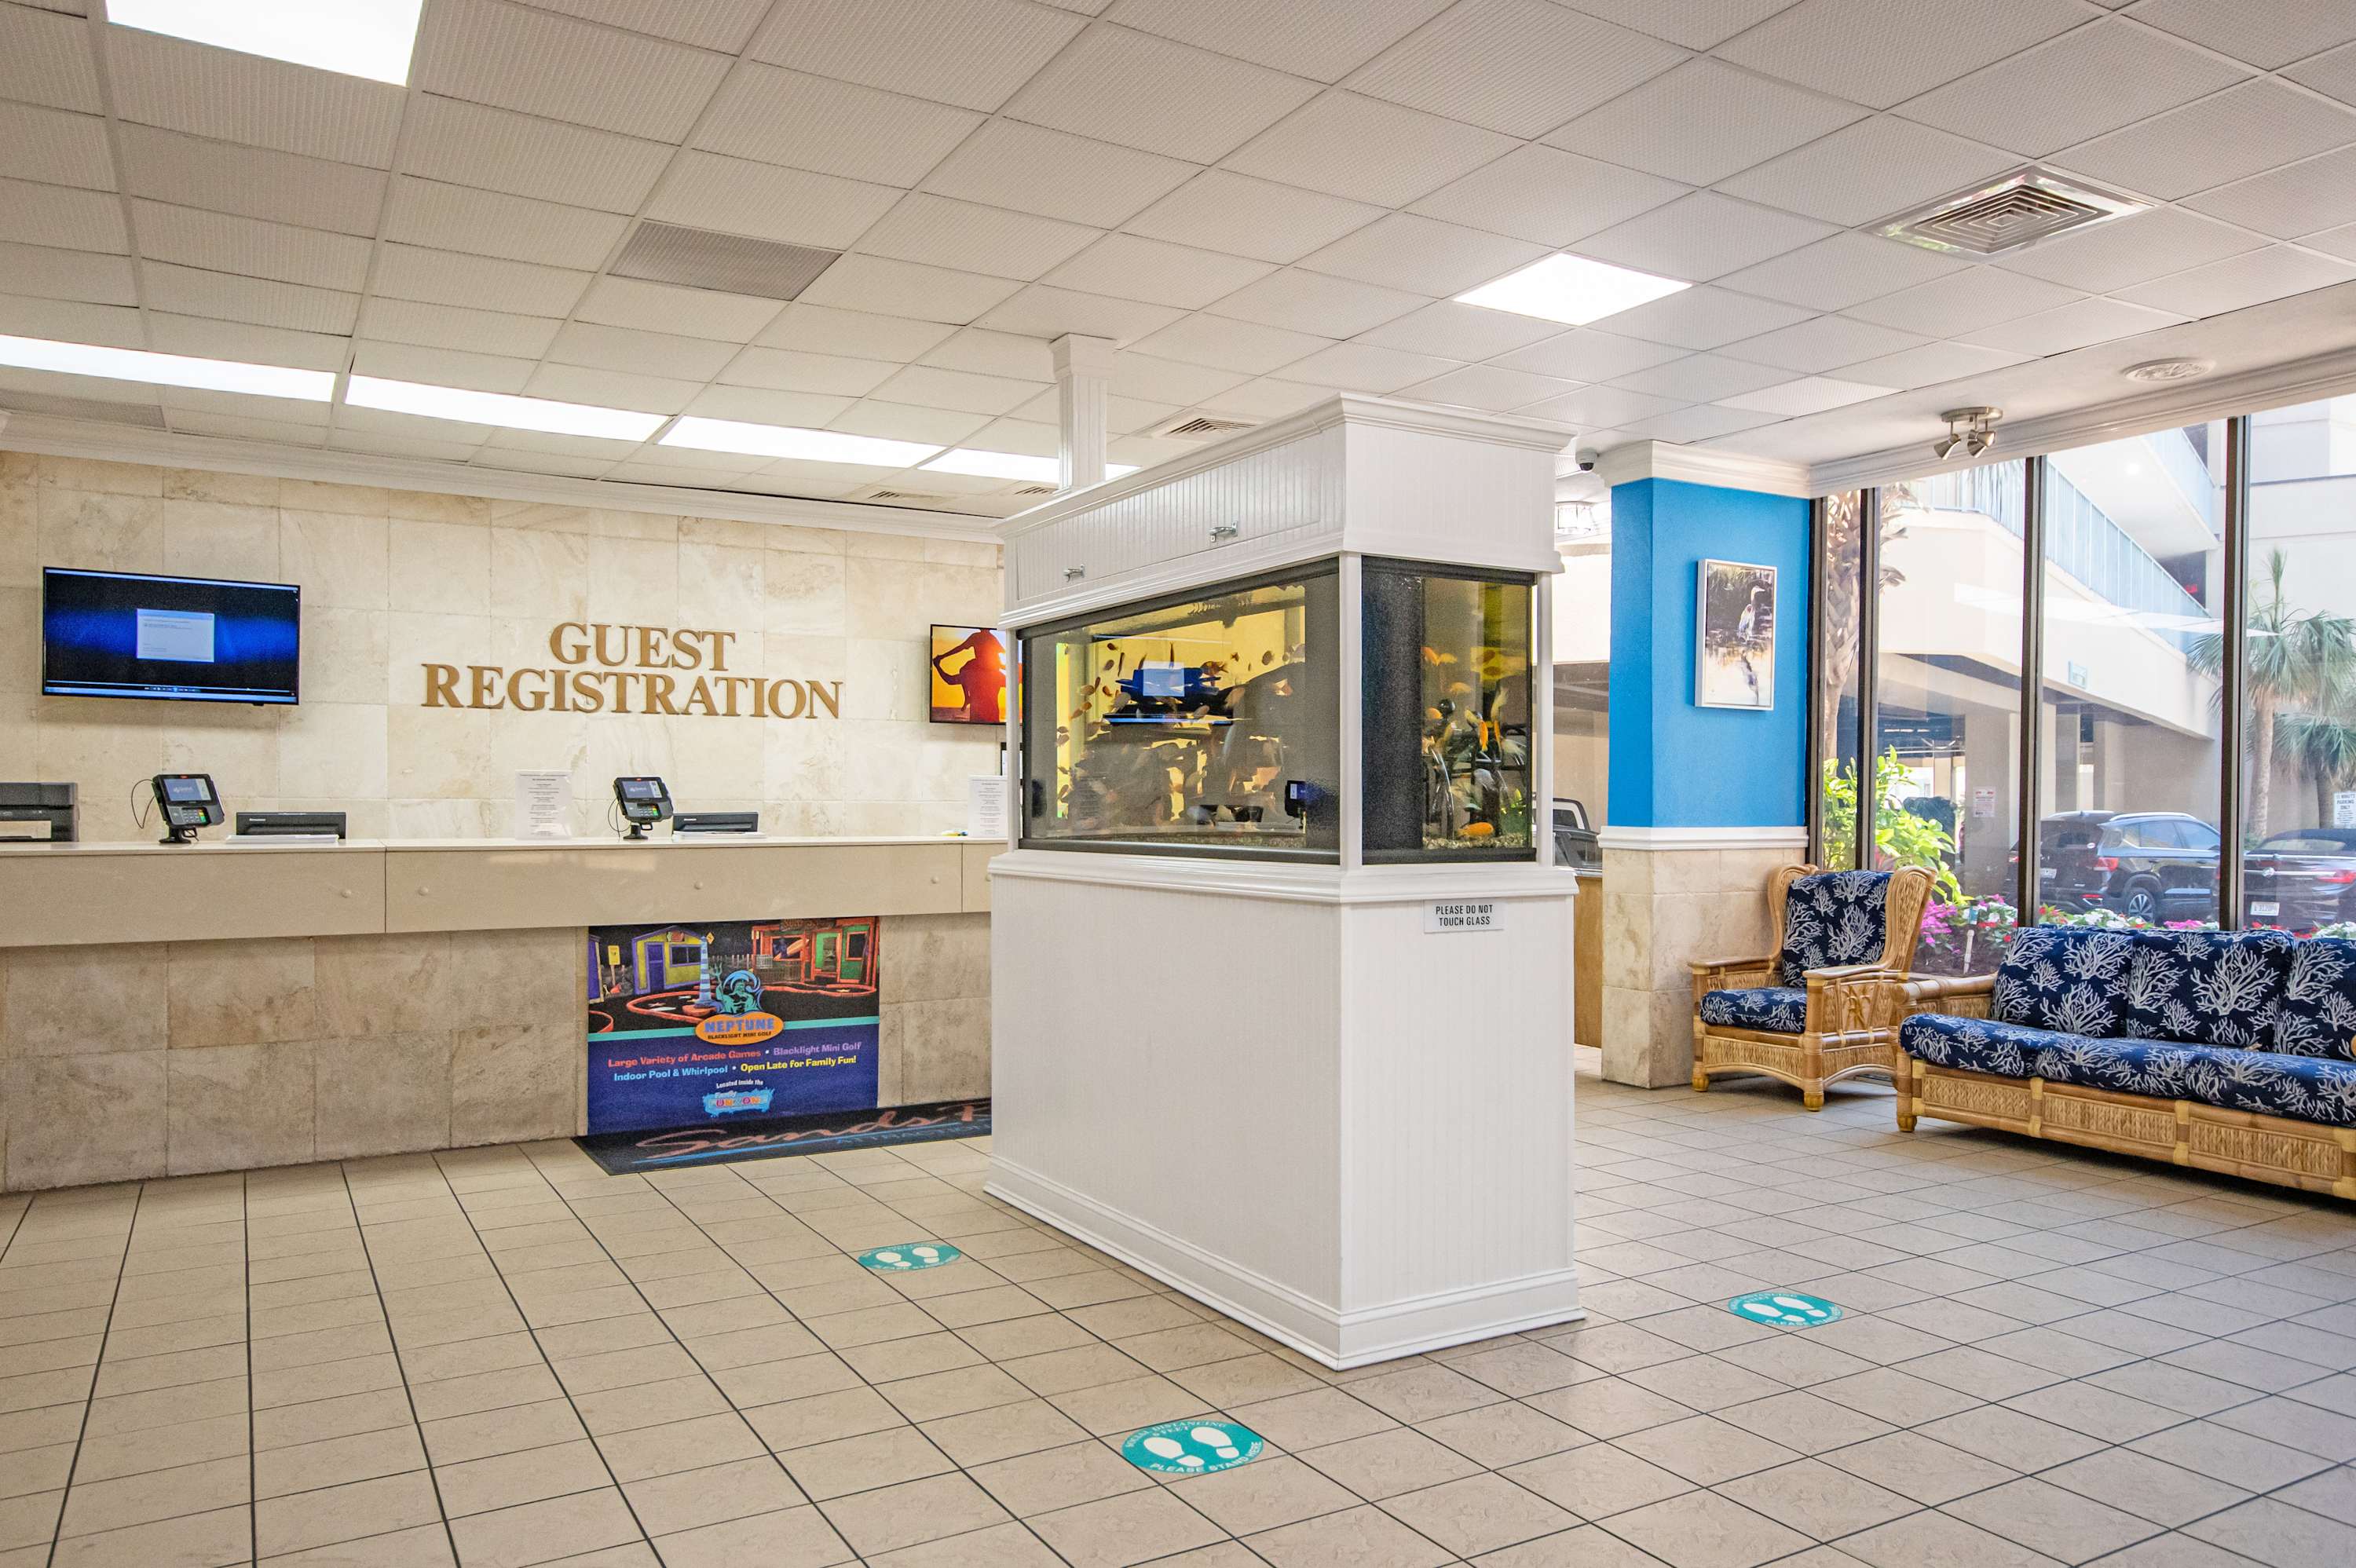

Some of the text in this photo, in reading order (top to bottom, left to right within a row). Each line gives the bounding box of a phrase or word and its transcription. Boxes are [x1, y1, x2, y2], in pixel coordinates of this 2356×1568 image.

[549, 621, 737, 671] GUEST
[420, 663, 844, 720] REGISTRATION
[1436, 905, 1493, 915] PLEASE DO NOT
[1439, 916, 1490, 927] TOUCH GLASS
[704, 1018, 774, 1033] NEPTUNE
[608, 1041, 862, 1068] Large Variety of Arcade Games Blacklight Mini Golf
[613, 1073, 646, 1081] Indoor
[649, 1069, 671, 1079] Pool
[682, 1065, 728, 1076] Whirlpool
[741, 1063, 765, 1073] Open
[766, 1061, 788, 1070] Late
[789, 1059, 804, 1068] for
[806, 1057, 836, 1067] Family
[838, 1055, 857, 1065] Fun!
[715, 1080, 737, 1089] Located
[635, 1110, 948, 1159] Sands
[1151, 1420, 1227, 1431] DISTANCING
[1149, 1462, 1205, 1473] PLEASE
[1209, 1456, 1249, 1472] STAND
